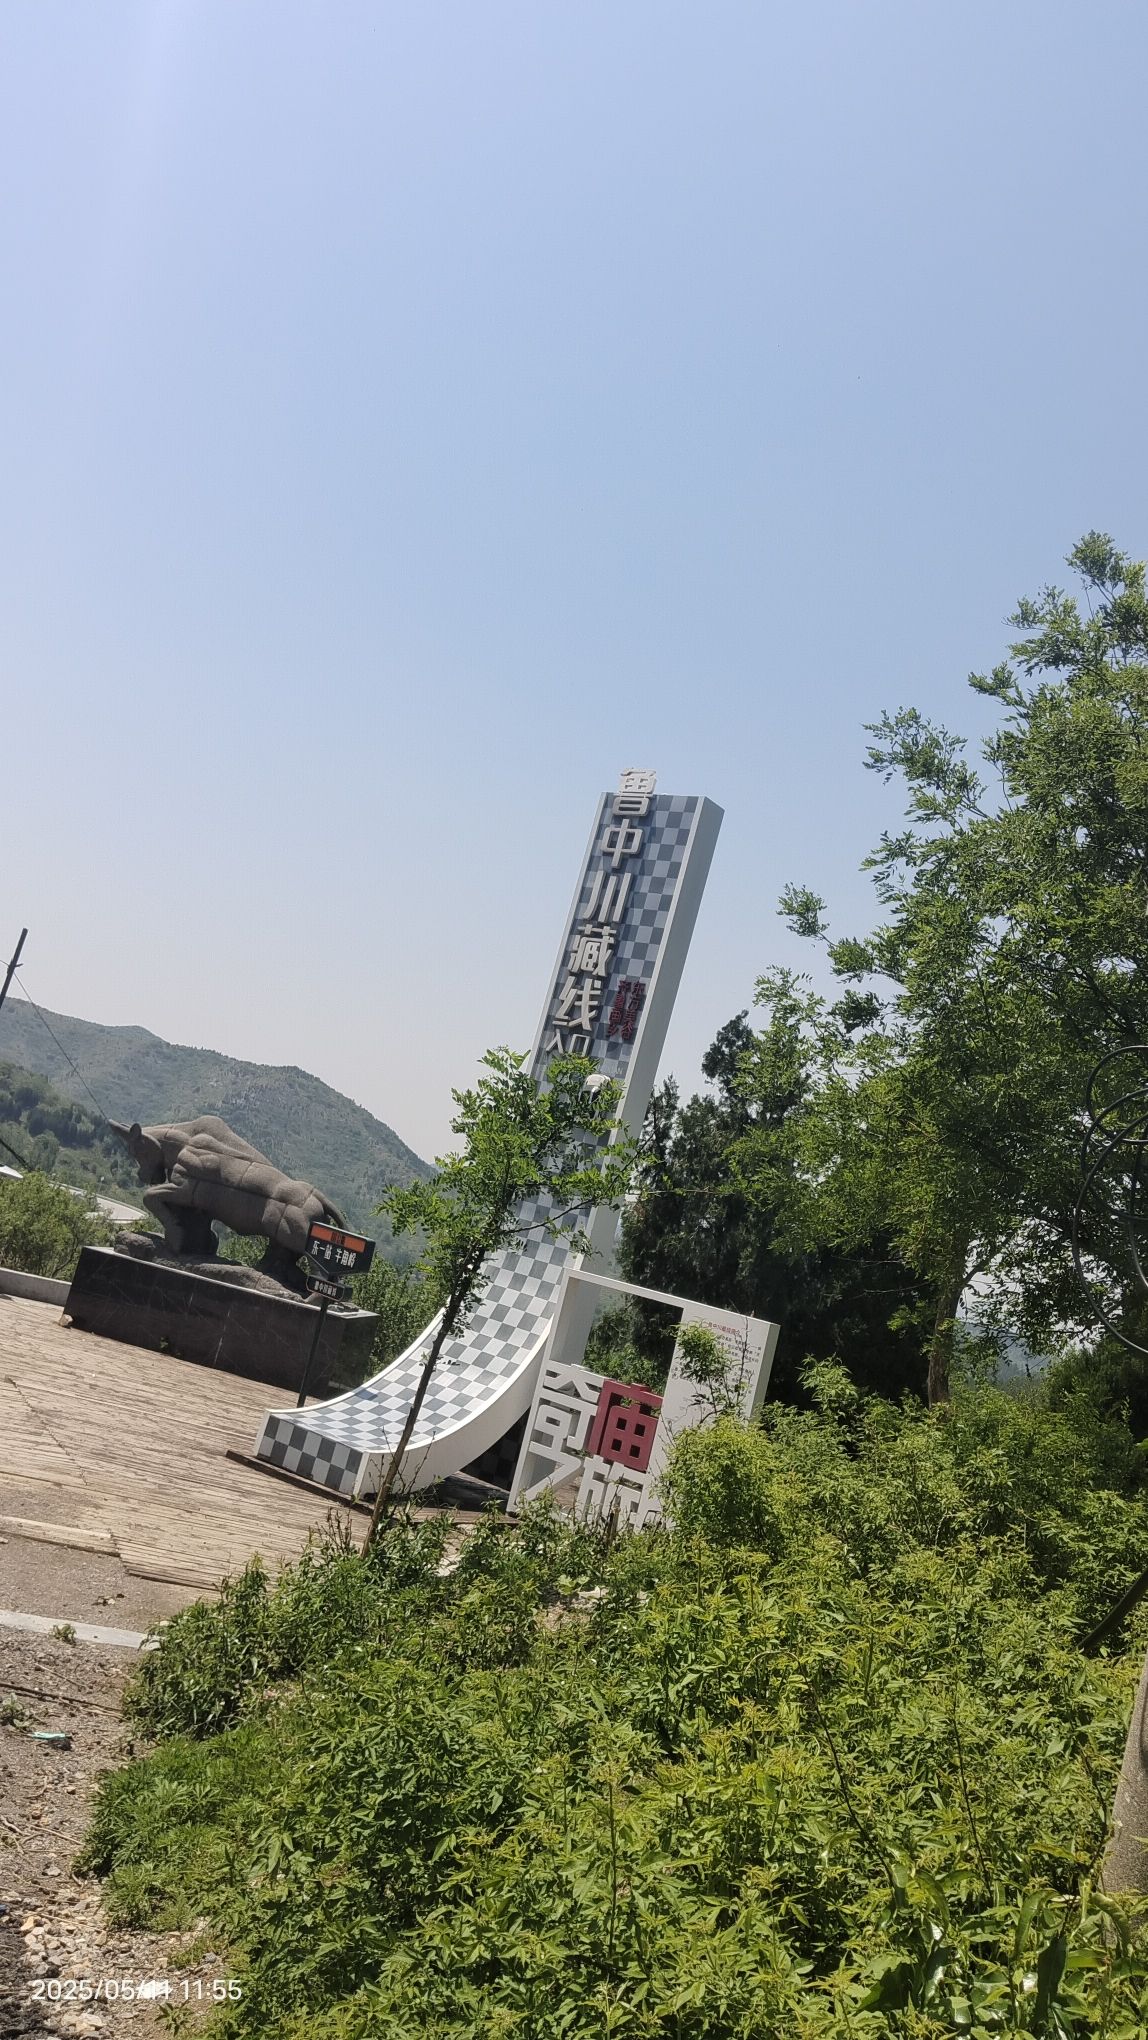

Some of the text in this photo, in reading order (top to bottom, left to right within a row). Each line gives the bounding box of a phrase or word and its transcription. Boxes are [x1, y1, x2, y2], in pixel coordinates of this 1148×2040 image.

[553, 767, 657, 1031] 鲁中川藏线
[546, 1028, 591, 1057] 入口
